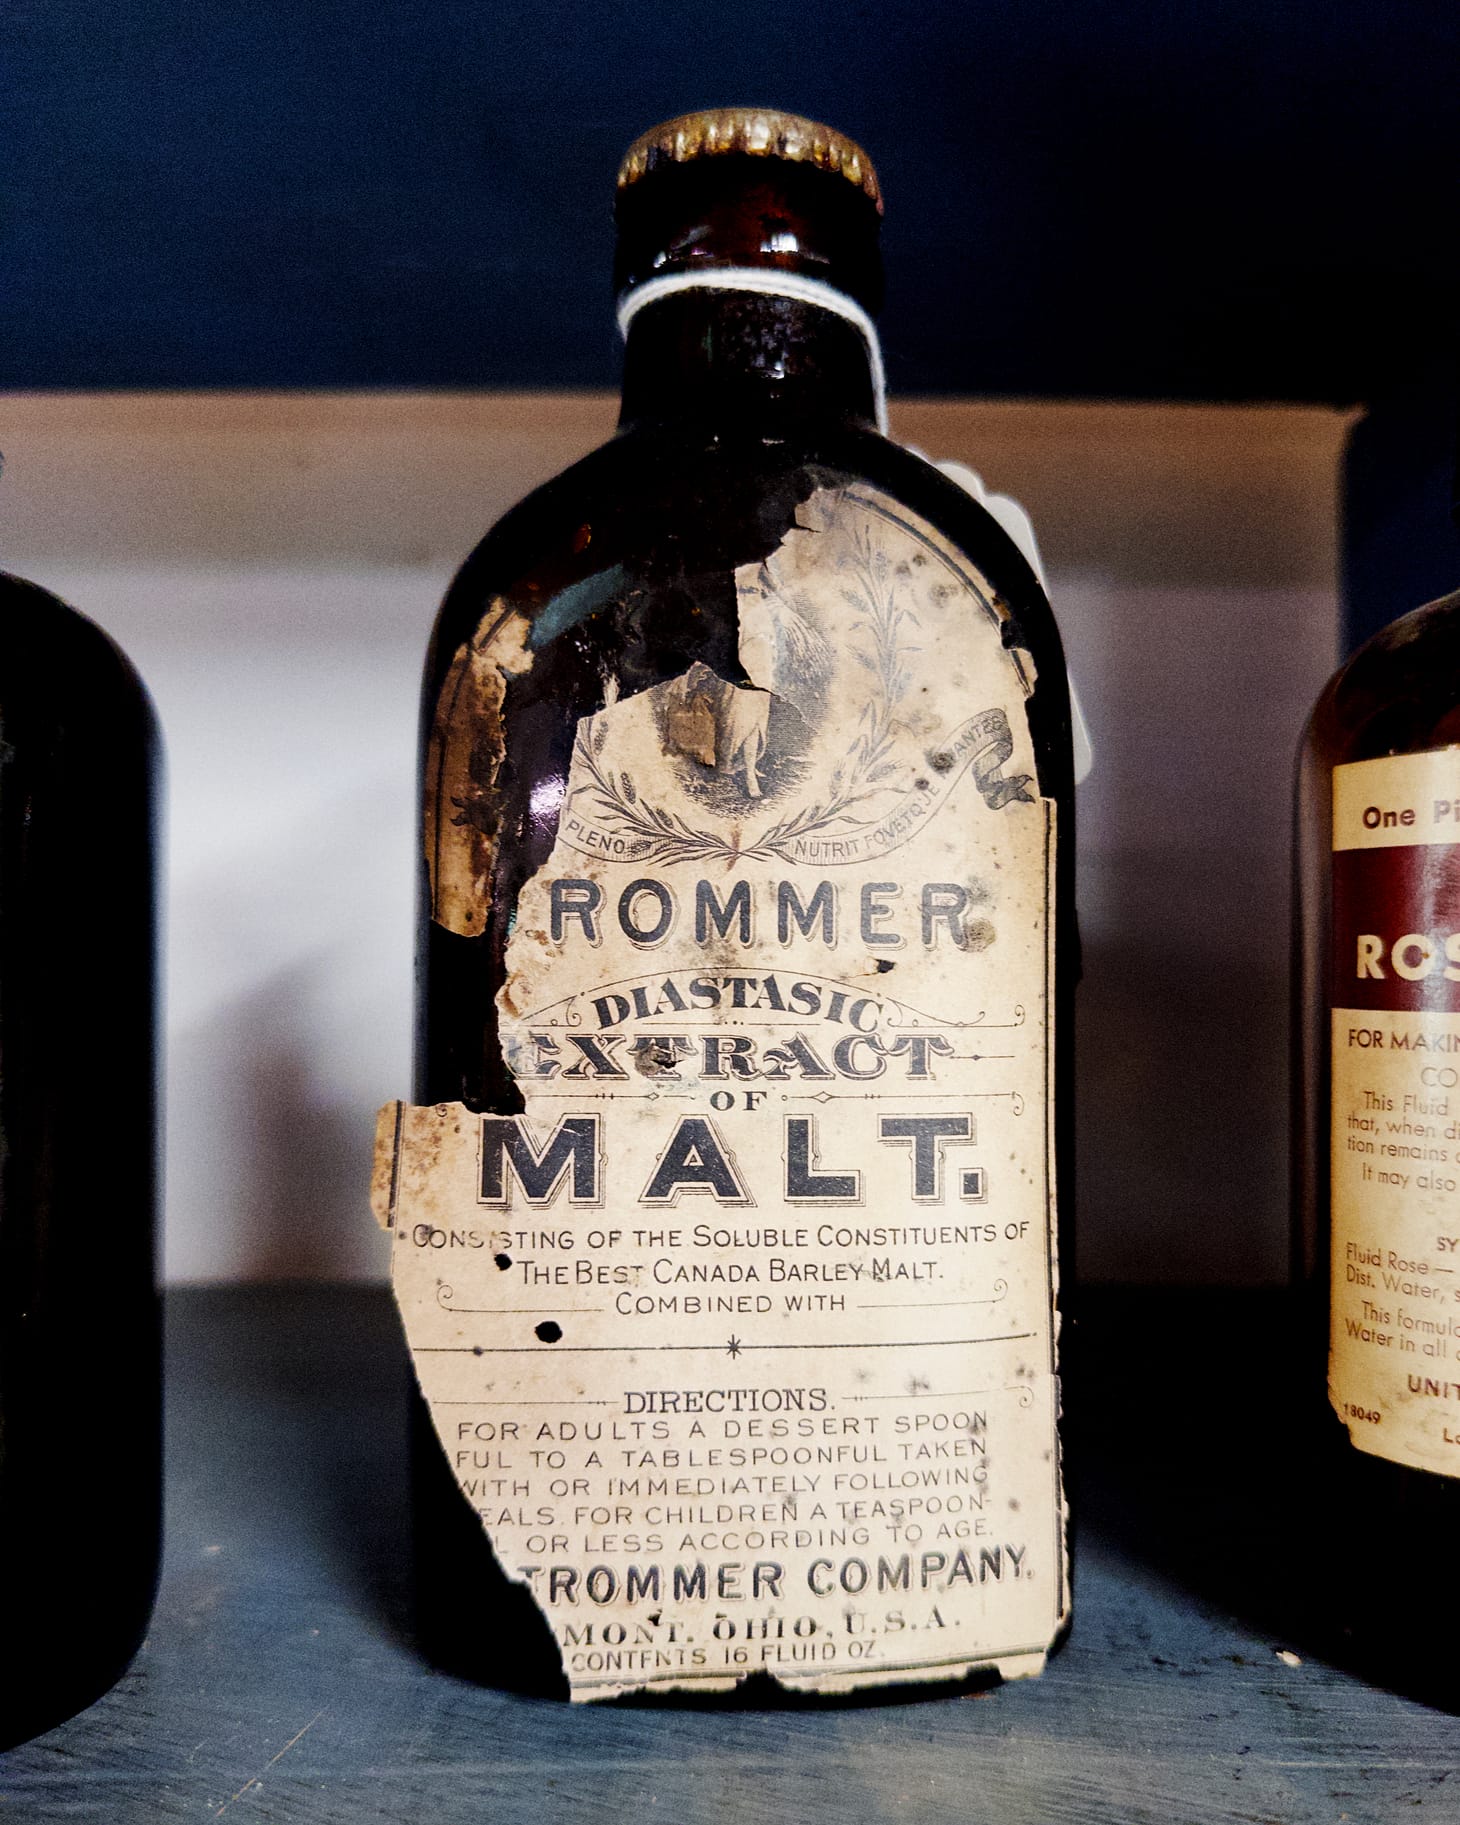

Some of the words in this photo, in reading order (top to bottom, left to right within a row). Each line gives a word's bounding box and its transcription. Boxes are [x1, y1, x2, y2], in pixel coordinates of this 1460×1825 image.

[1363, 807, 1415, 829] One
[565, 819, 625, 854] PLENO
[794, 839, 858, 857] NUTRIT
[550, 878, 978, 951] ROMMER
[591, 972, 885, 1032] DIASTASIC
[1349, 1029, 1383, 1048] FOR
[501, 1032, 954, 1081] EXTRACT
[709, 1090, 768, 1111] OF
[1363, 1090, 1393, 1111] This
[1403, 1095, 1448, 1116] Fluid
[1347, 1111, 1379, 1135] that,
[1386, 1117, 1435, 1138] when
[477, 1112, 988, 1209] MALT.
[1347, 1136, 1374, 1154] tion
[1381, 1143, 1447, 1162] remains
[1378, 1171, 1409, 1190] may
[1416, 1170, 1456, 1192] also
[587, 1230, 622, 1248] OF
[633, 1230, 682, 1247] THE
[693, 1224, 808, 1248] SOLUBLE
[817, 1223, 997, 1247] CONSTITUENTS
[1004, 1221, 1030, 1240] OF
[517, 1260, 568, 1284] THE
[576, 1260, 643, 1284] BEST
[653, 1258, 760, 1284] CANADA
[769, 1258, 863, 1282] BARLEY
[872, 1257, 943, 1283] MALT.
[1346, 1242, 1381, 1266] Fluid
[1388, 1251, 1429, 1275] Rose
[1346, 1264, 1376, 1289] Dist.
[1382, 1271, 1445, 1305] Water,
[615, 1291, 772, 1315] COMBINED
[784, 1295, 845, 1312] WITH
[1362, 1301, 1391, 1325] This
[1345, 1318, 1393, 1347] Water
[1400, 1333, 1415, 1353] in
[1423, 1336, 1448, 1358] all
[624, 1388, 836, 1414] DIRECTIONS.
[1344, 1403, 1381, 1424] 18049
[458, 1422, 518, 1440] FOR
[536, 1420, 669, 1440] ADULTS
[688, 1420, 705, 1438] A
[724, 1416, 879, 1438] DESSERT
[895, 1410, 988, 1434] SPOON
[456, 1450, 512, 1468] FUL
[529, 1450, 565, 1469] TO
[584, 1450, 602, 1468] A
[622, 1445, 887, 1467] TABLESPOONFUL
[897, 1437, 986, 1460] TAKEN
[461, 1479, 530, 1497] WITH
[550, 1479, 590, 1497] OR
[608, 1474, 821, 1496] IMMEDIATELY
[834, 1465, 988, 1490] FOLLOWING
[575, 1506, 633, 1525] FOR
[645, 1501, 798, 1525] CHILDREN
[810, 1502, 827, 1520] A
[526, 1535, 568, 1553] OR
[585, 1533, 663, 1553] LESS
[679, 1527, 870, 1551] ACCORDING
[886, 1523, 923, 1543] TO
[936, 1518, 993, 1540] AGE.
[517, 1561, 784, 1607] TROMMER
[807, 1543, 1034, 1598] COMPANY.
[724, 1645, 748, 1664] 16
[761, 1641, 837, 1662] FLUID
